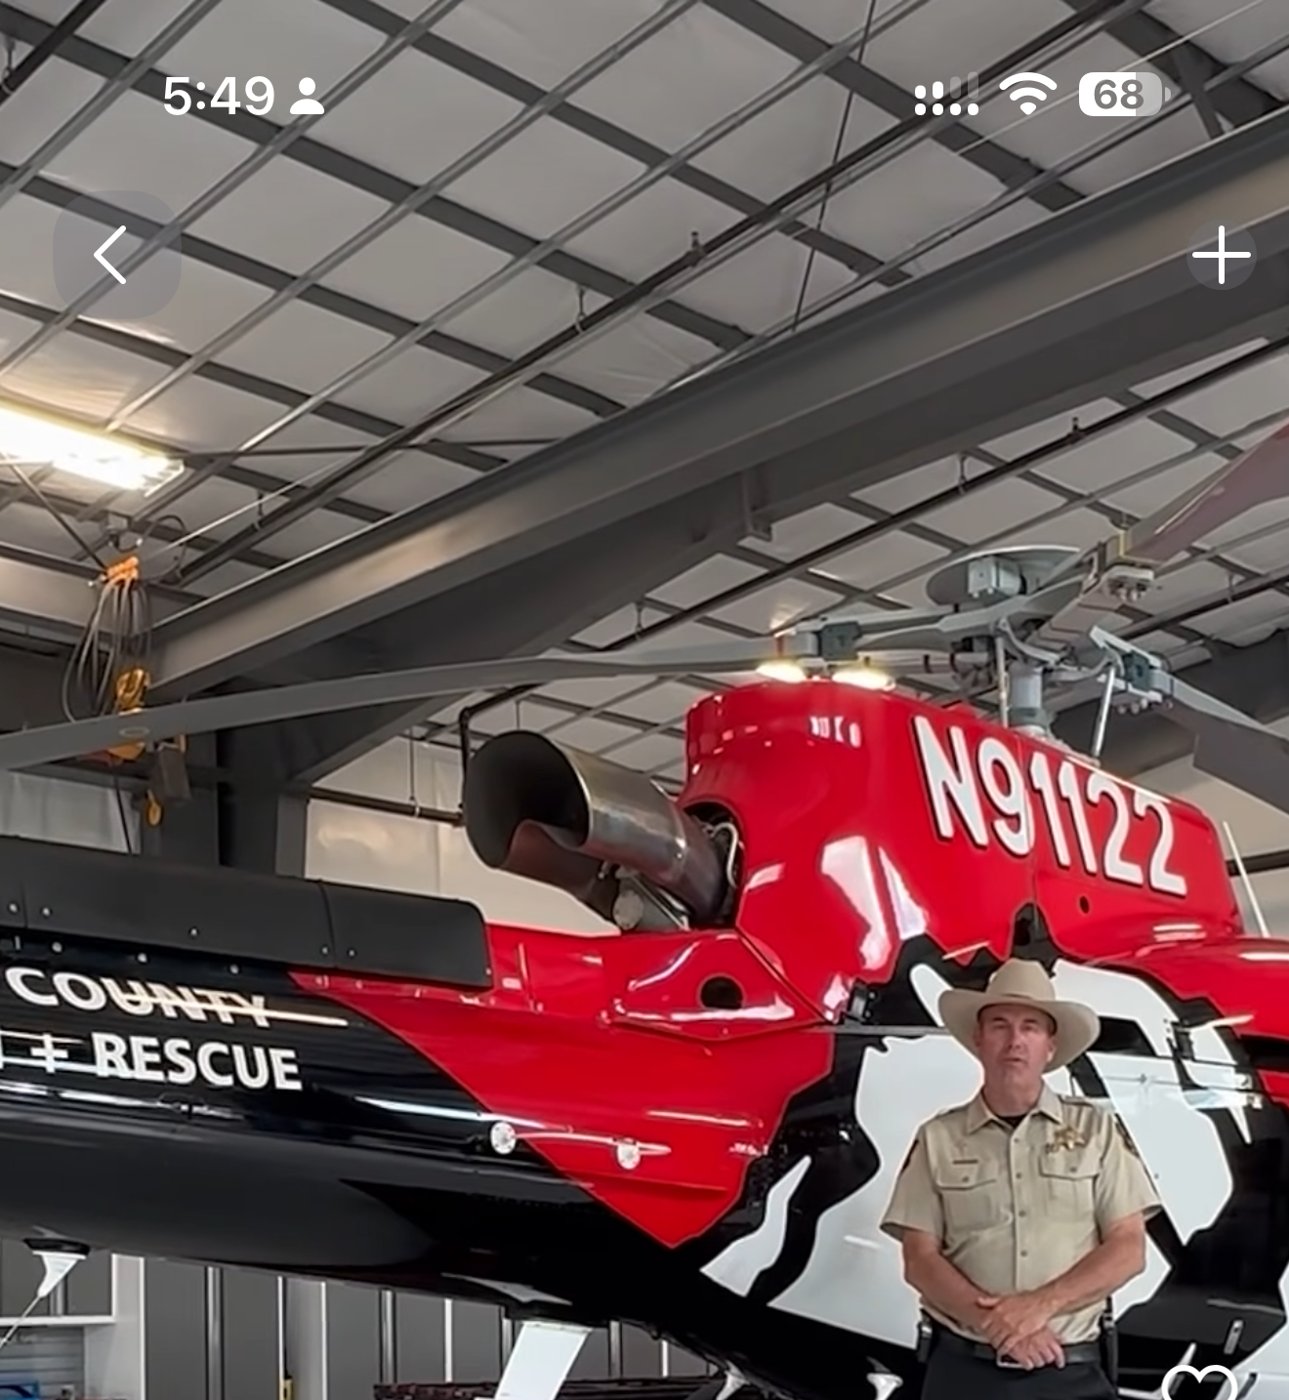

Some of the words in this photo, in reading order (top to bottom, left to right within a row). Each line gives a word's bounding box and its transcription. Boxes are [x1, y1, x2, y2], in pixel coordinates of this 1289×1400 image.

[914, 715, 1187, 897] N91122
[5, 967, 270, 1027] COUNTY
[91, 1032, 302, 1090] RESCUE
